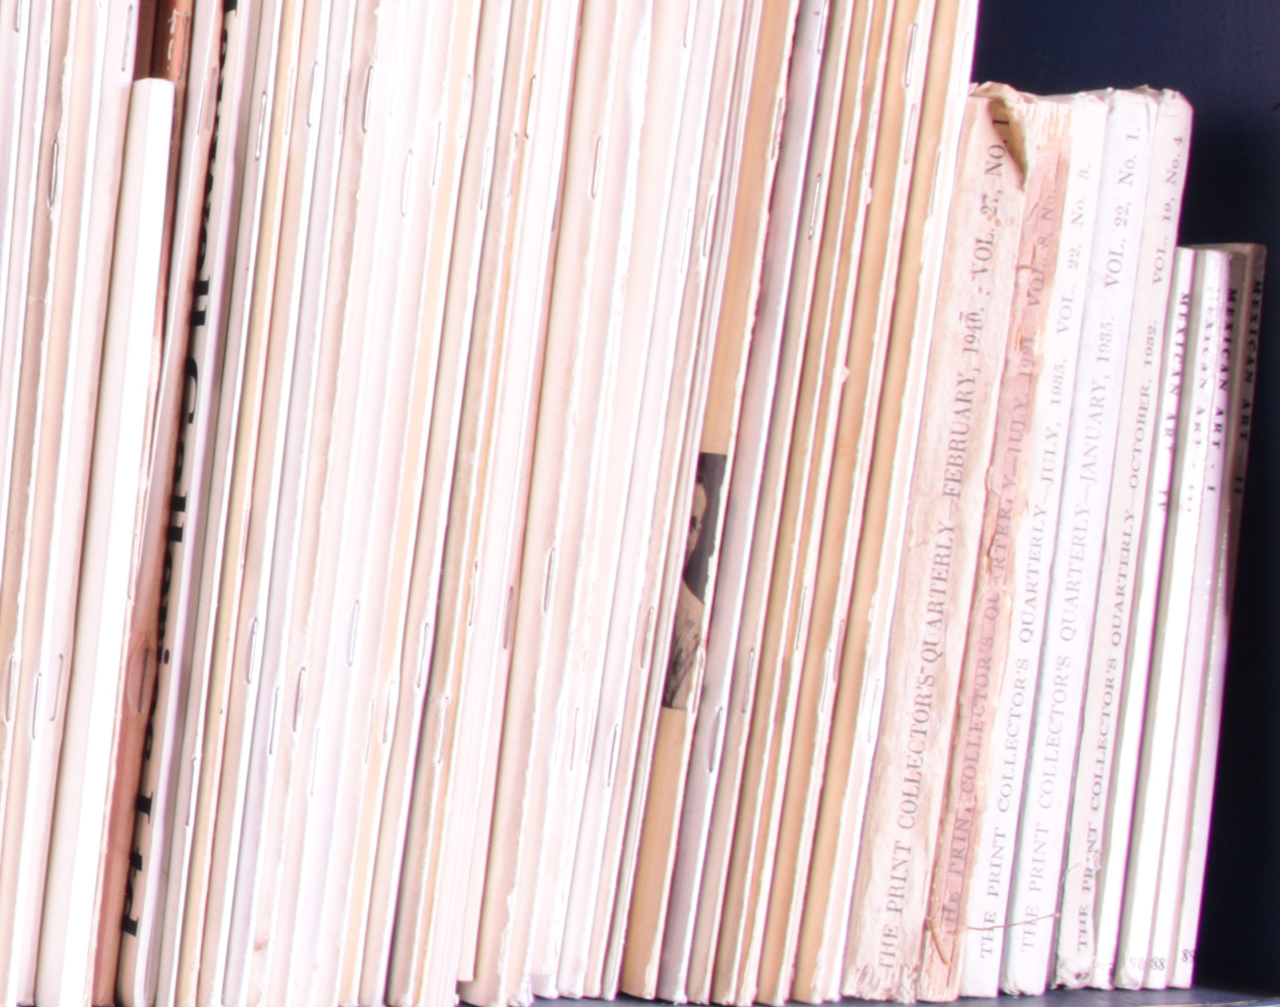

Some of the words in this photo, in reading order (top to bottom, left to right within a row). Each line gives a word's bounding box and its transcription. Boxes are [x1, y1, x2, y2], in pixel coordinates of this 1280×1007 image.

[1019, 905, 1038, 953] THE
[1029, 822, 1047, 891] PRINT
[1039, 655, 1070, 809] COLLECTOR'S
[1105, 237, 1127, 288] VOL.
[1118, 157, 1136, 187] No.
[897, 669, 934, 830] COLLECTOR'S
[887, 841, 911, 916] PRINT
[879, 924, 899, 969] THE
